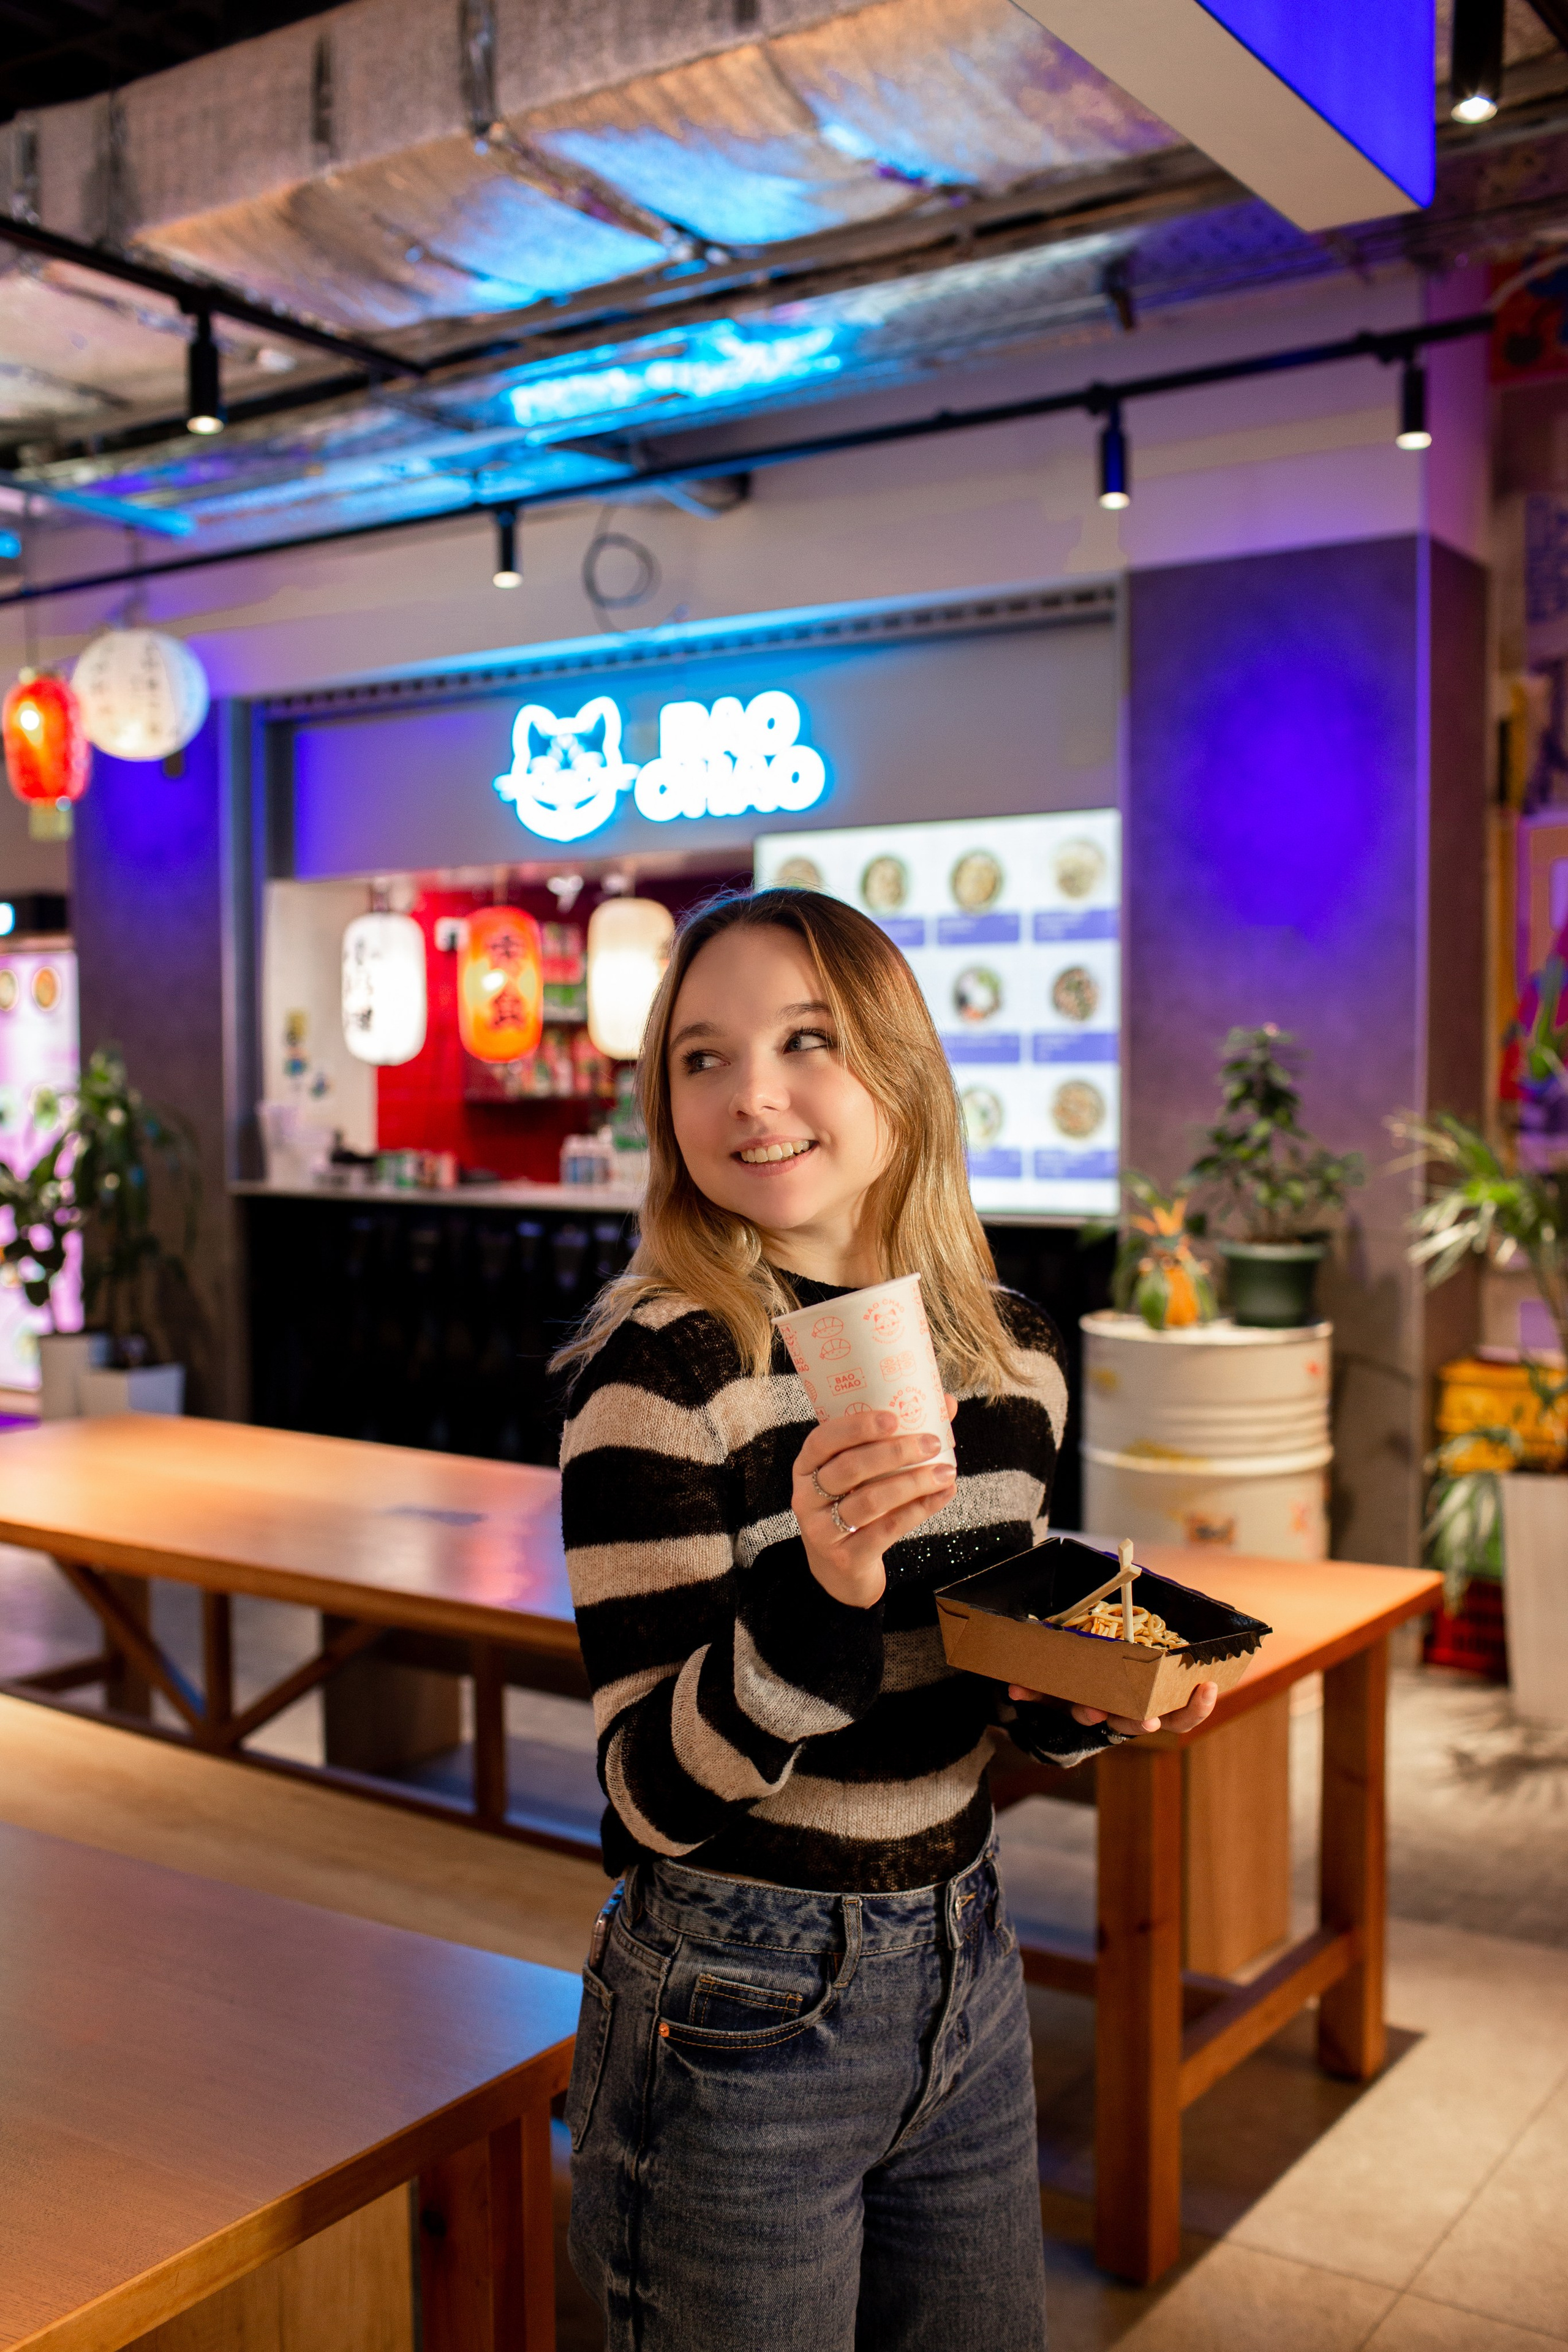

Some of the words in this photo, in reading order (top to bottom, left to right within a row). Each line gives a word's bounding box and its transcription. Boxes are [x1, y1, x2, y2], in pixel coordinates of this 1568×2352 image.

[863, 1302, 880, 1321] BAO
[882, 1298, 905, 1313] CHAO
[834, 1379, 861, 1392] CHAO
[835, 1373, 855, 1384] BAO
[889, 1389, 903, 1408] BAO
[905, 1386, 927, 1401] CHAO
